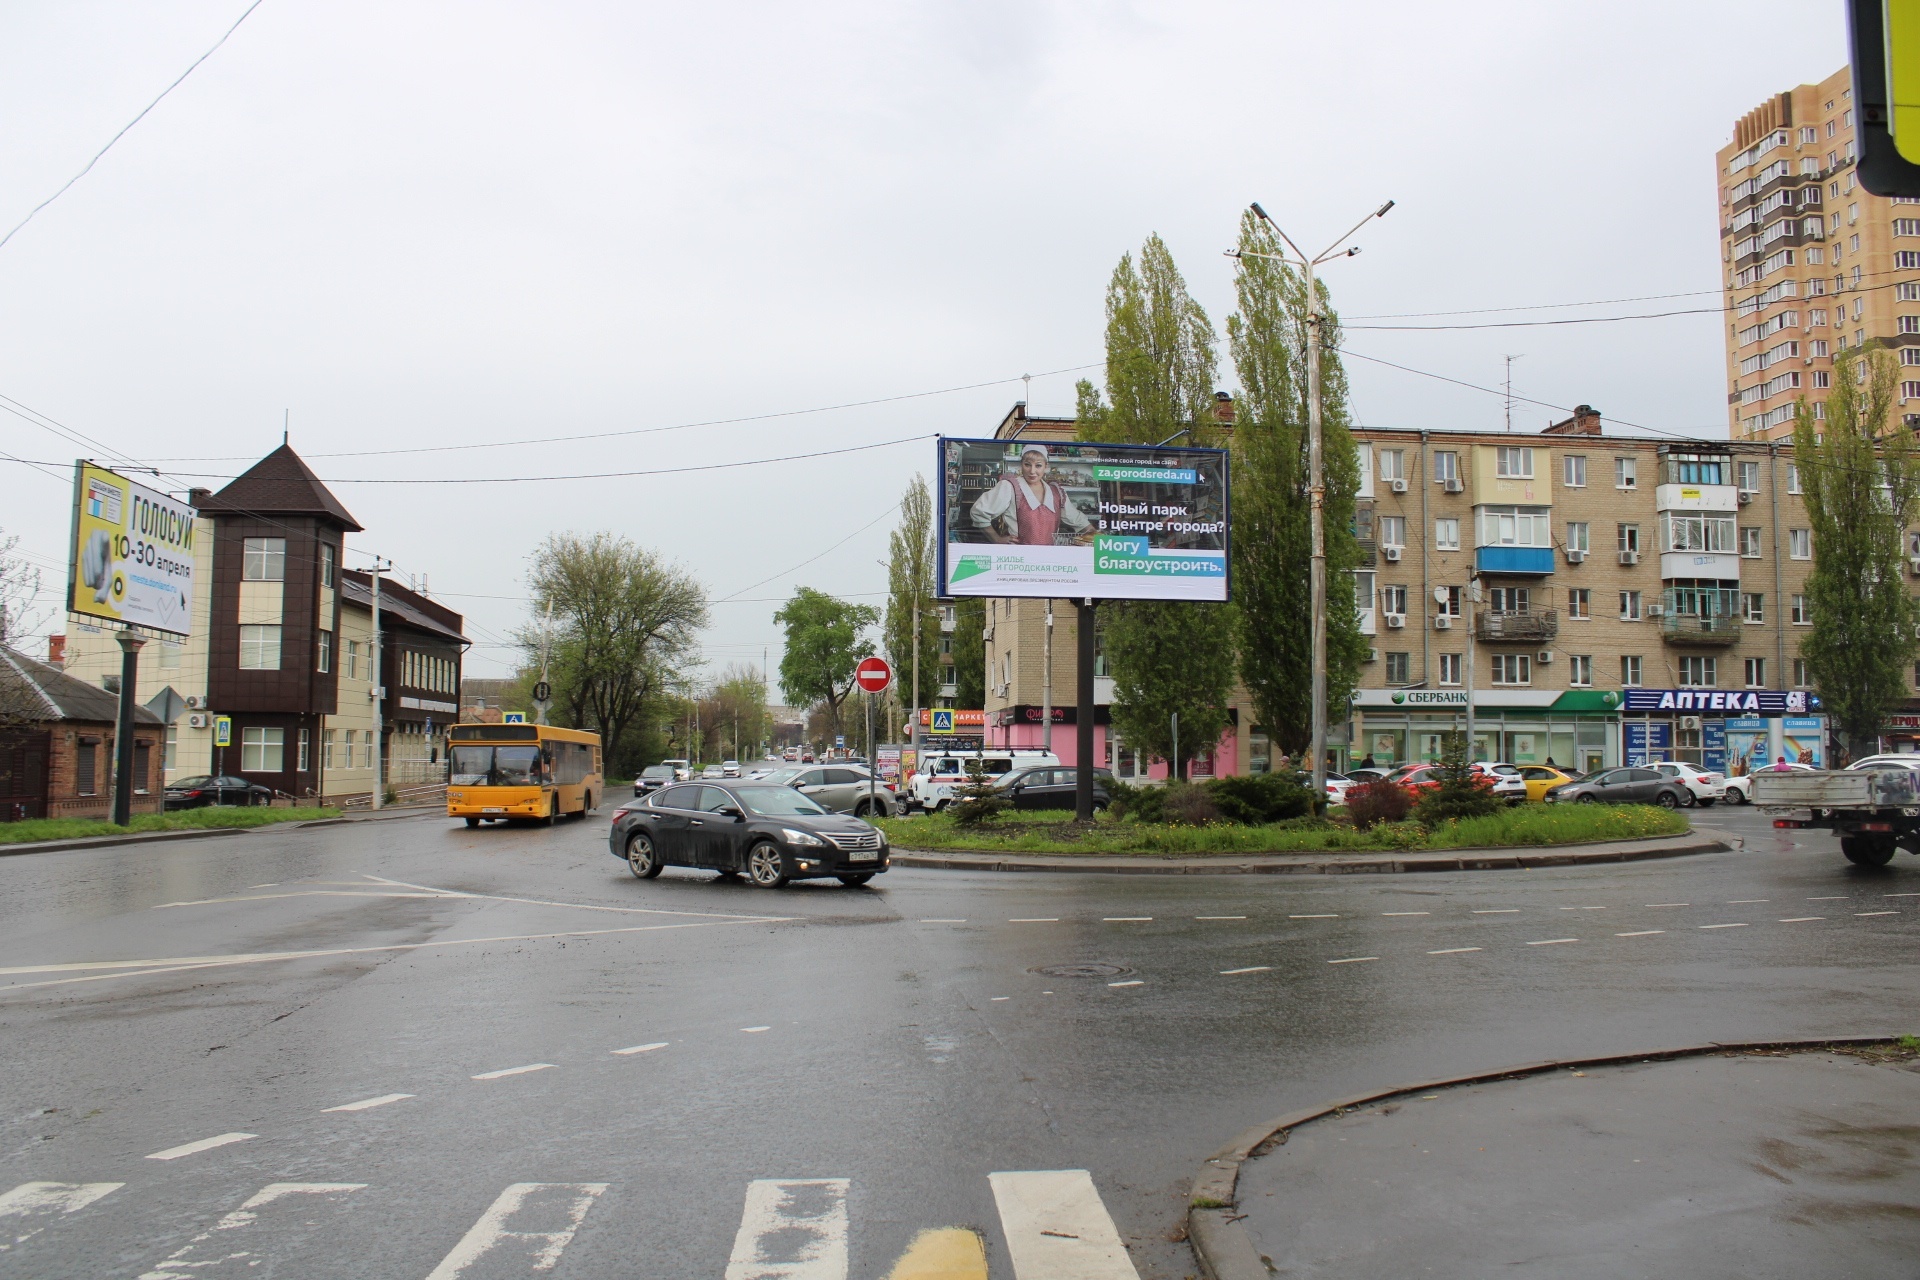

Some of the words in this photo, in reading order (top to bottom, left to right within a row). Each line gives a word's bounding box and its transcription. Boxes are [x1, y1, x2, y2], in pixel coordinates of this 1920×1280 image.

[1098, 468, 1192, 480] za.gorodsreda.ru
[1099, 502, 1148, 515] Новый
[1152, 505, 1188, 517] парк
[132, 494, 194, 551] ГОЛОСУЙ
[1099, 520, 1107, 529] в
[1111, 520, 1163, 533] центре
[1167, 521, 1225, 534] города?
[1099, 539, 1140, 555] Могу
[114, 533, 155, 567] 10-30
[157, 555, 190, 579] апреля
[1003, 565, 1051, 573] ГОРОДСКАЯ
[1098, 556, 1222, 573] благоустроить.
[1408, 693, 1467, 703] СБЕРБАНК
[1659, 692, 1760, 709] АПТЕКА
